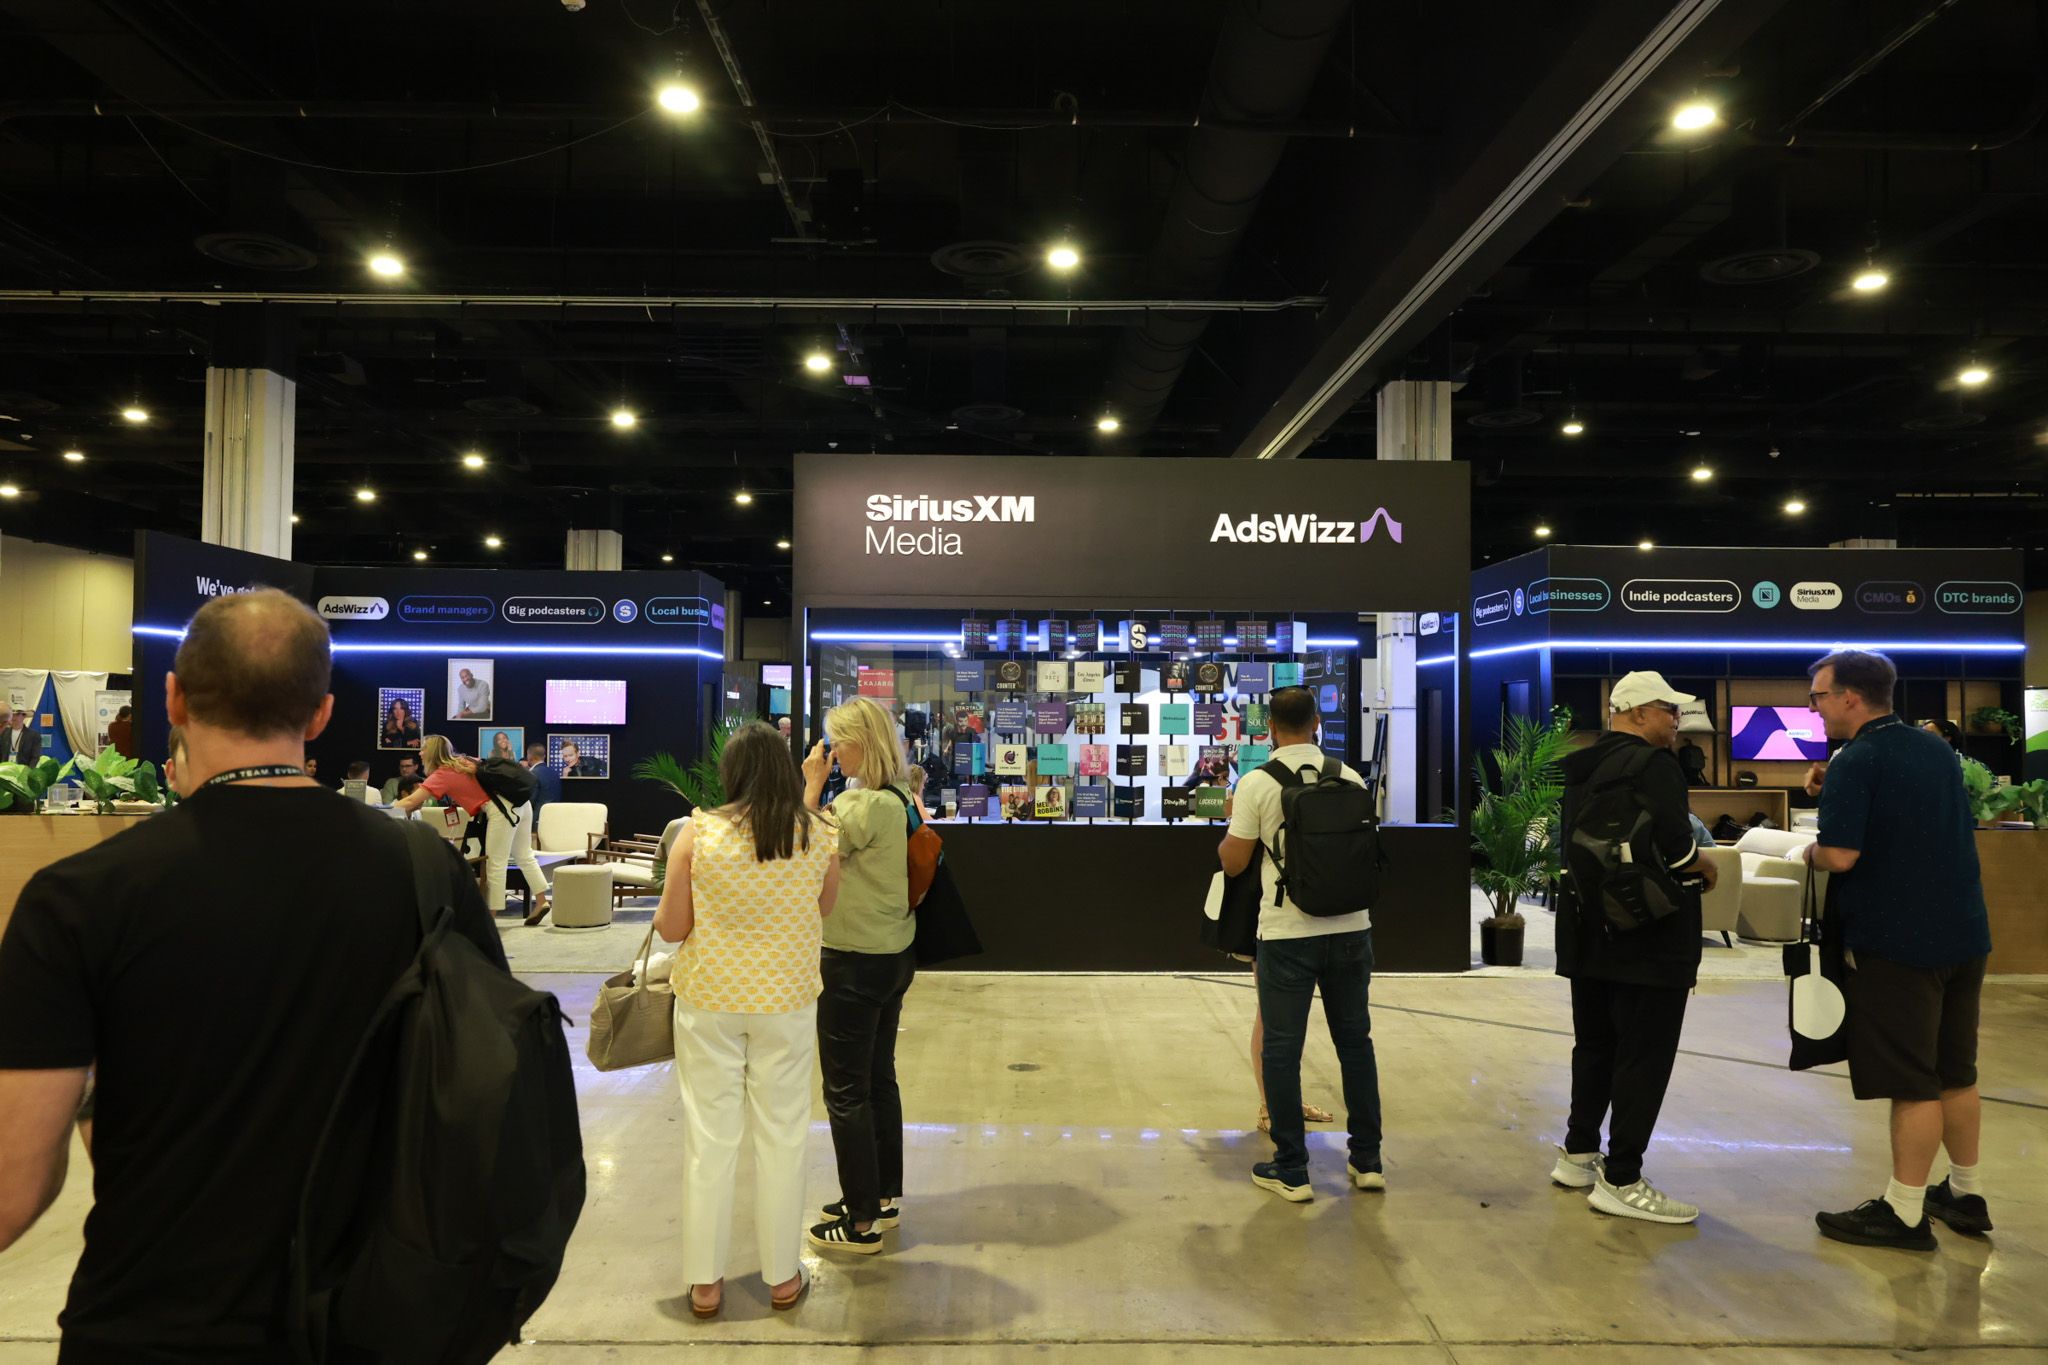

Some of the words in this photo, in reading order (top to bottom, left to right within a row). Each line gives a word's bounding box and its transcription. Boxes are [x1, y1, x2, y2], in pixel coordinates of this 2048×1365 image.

[866, 494, 1035, 522] SiriusXM
[1210, 513, 1355, 543] AdsWizz
[865, 525, 963, 555] Media
[196, 575, 234, 597] We've
[1529, 591, 1542, 604] Local
[1543, 589, 1602, 601] businesses
[1629, 591, 1660, 601] Indie
[1664, 591, 1733, 603] podcasters
[1797, 588, 1835, 596] SiriusXM
[1863, 592, 1900, 602] CMOs
[1797, 595, 1820, 603] Media
[1943, 593, 1969, 603] DTC
[1972, 593, 2015, 604] brands
[323, 604, 369, 614] AdsWizz
[404, 605, 435, 614] Brand
[437, 606, 488, 616] managers
[509, 605, 526, 617] Big
[528, 606, 586, 617] podcasters
[651, 606, 679, 616] Local
[1475, 608, 1483, 618] Big
[1483, 603, 1504, 617] podcasters
[1037, 806, 1064, 815] ROBBINS
